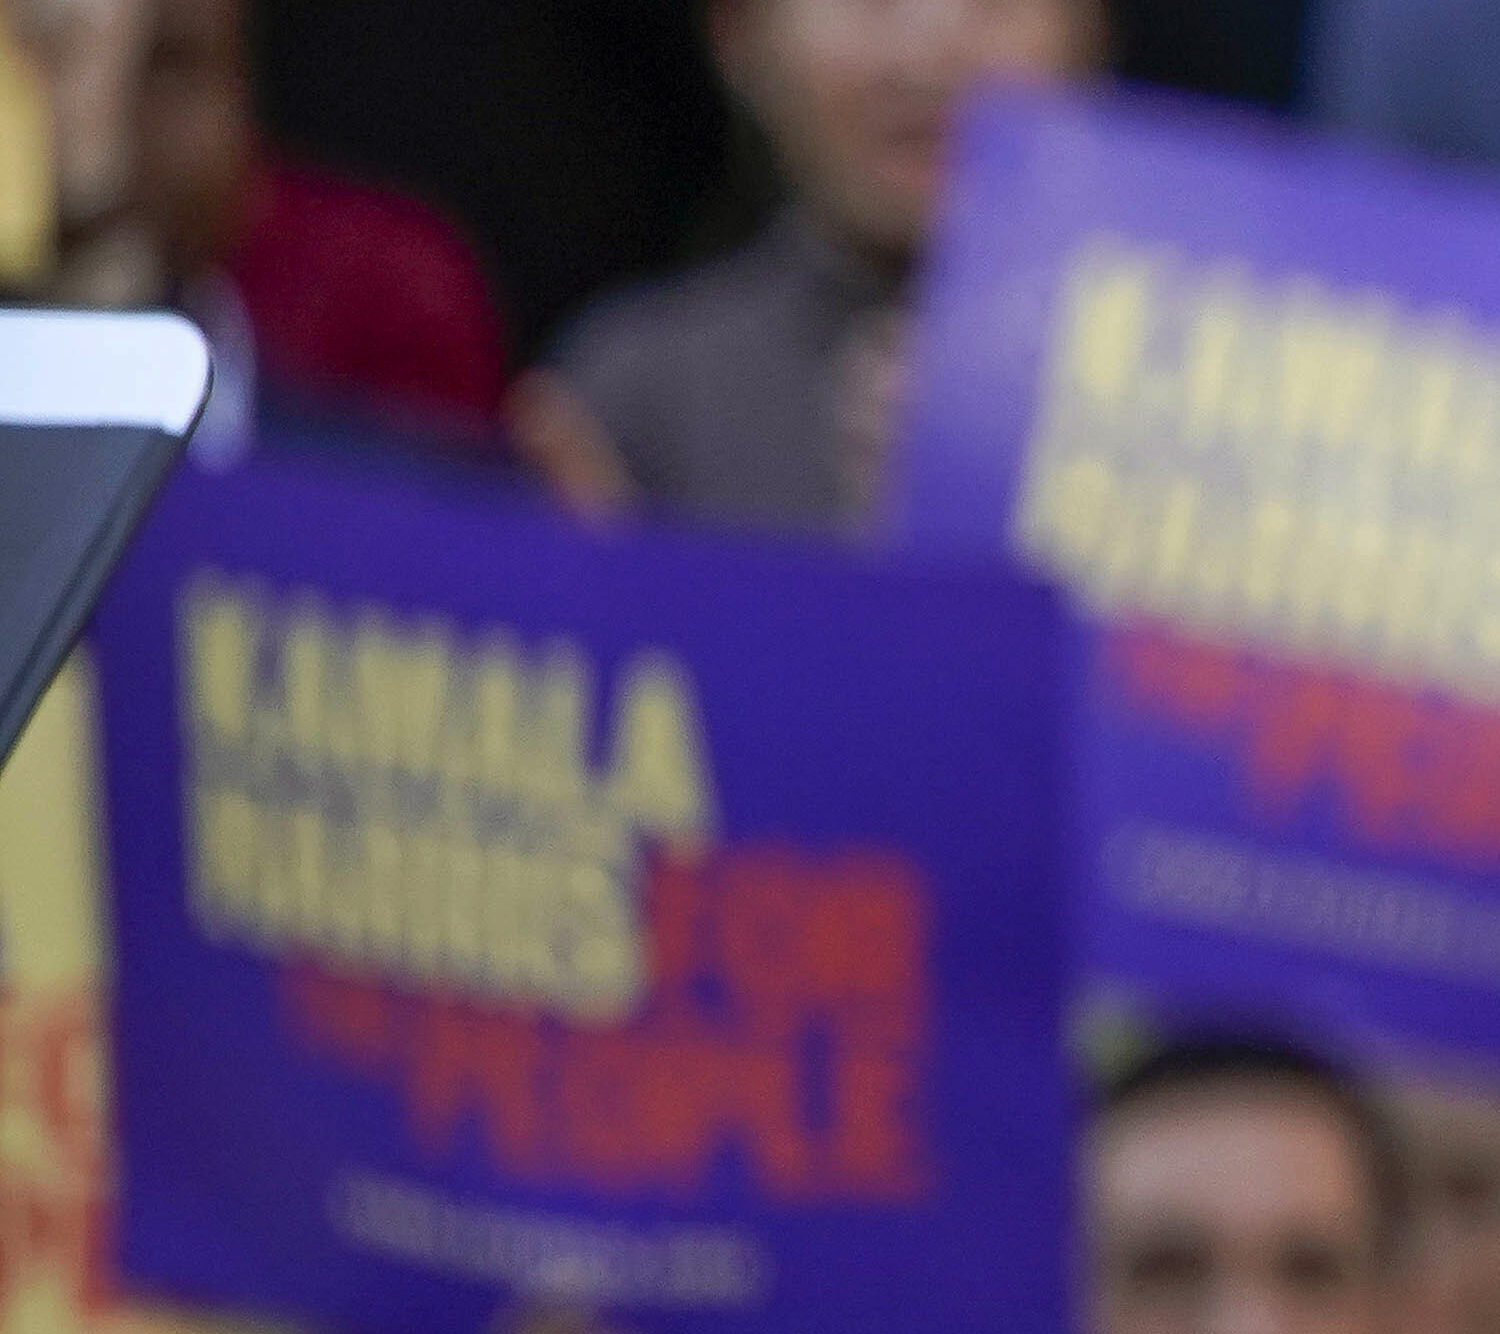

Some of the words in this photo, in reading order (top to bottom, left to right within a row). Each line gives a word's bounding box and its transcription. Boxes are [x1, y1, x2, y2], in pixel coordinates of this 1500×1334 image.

[178, 572, 718, 852] KAMALA
[185, 779, 646, 1030] HARRIS
[644, 837, 932, 1035] FOR
